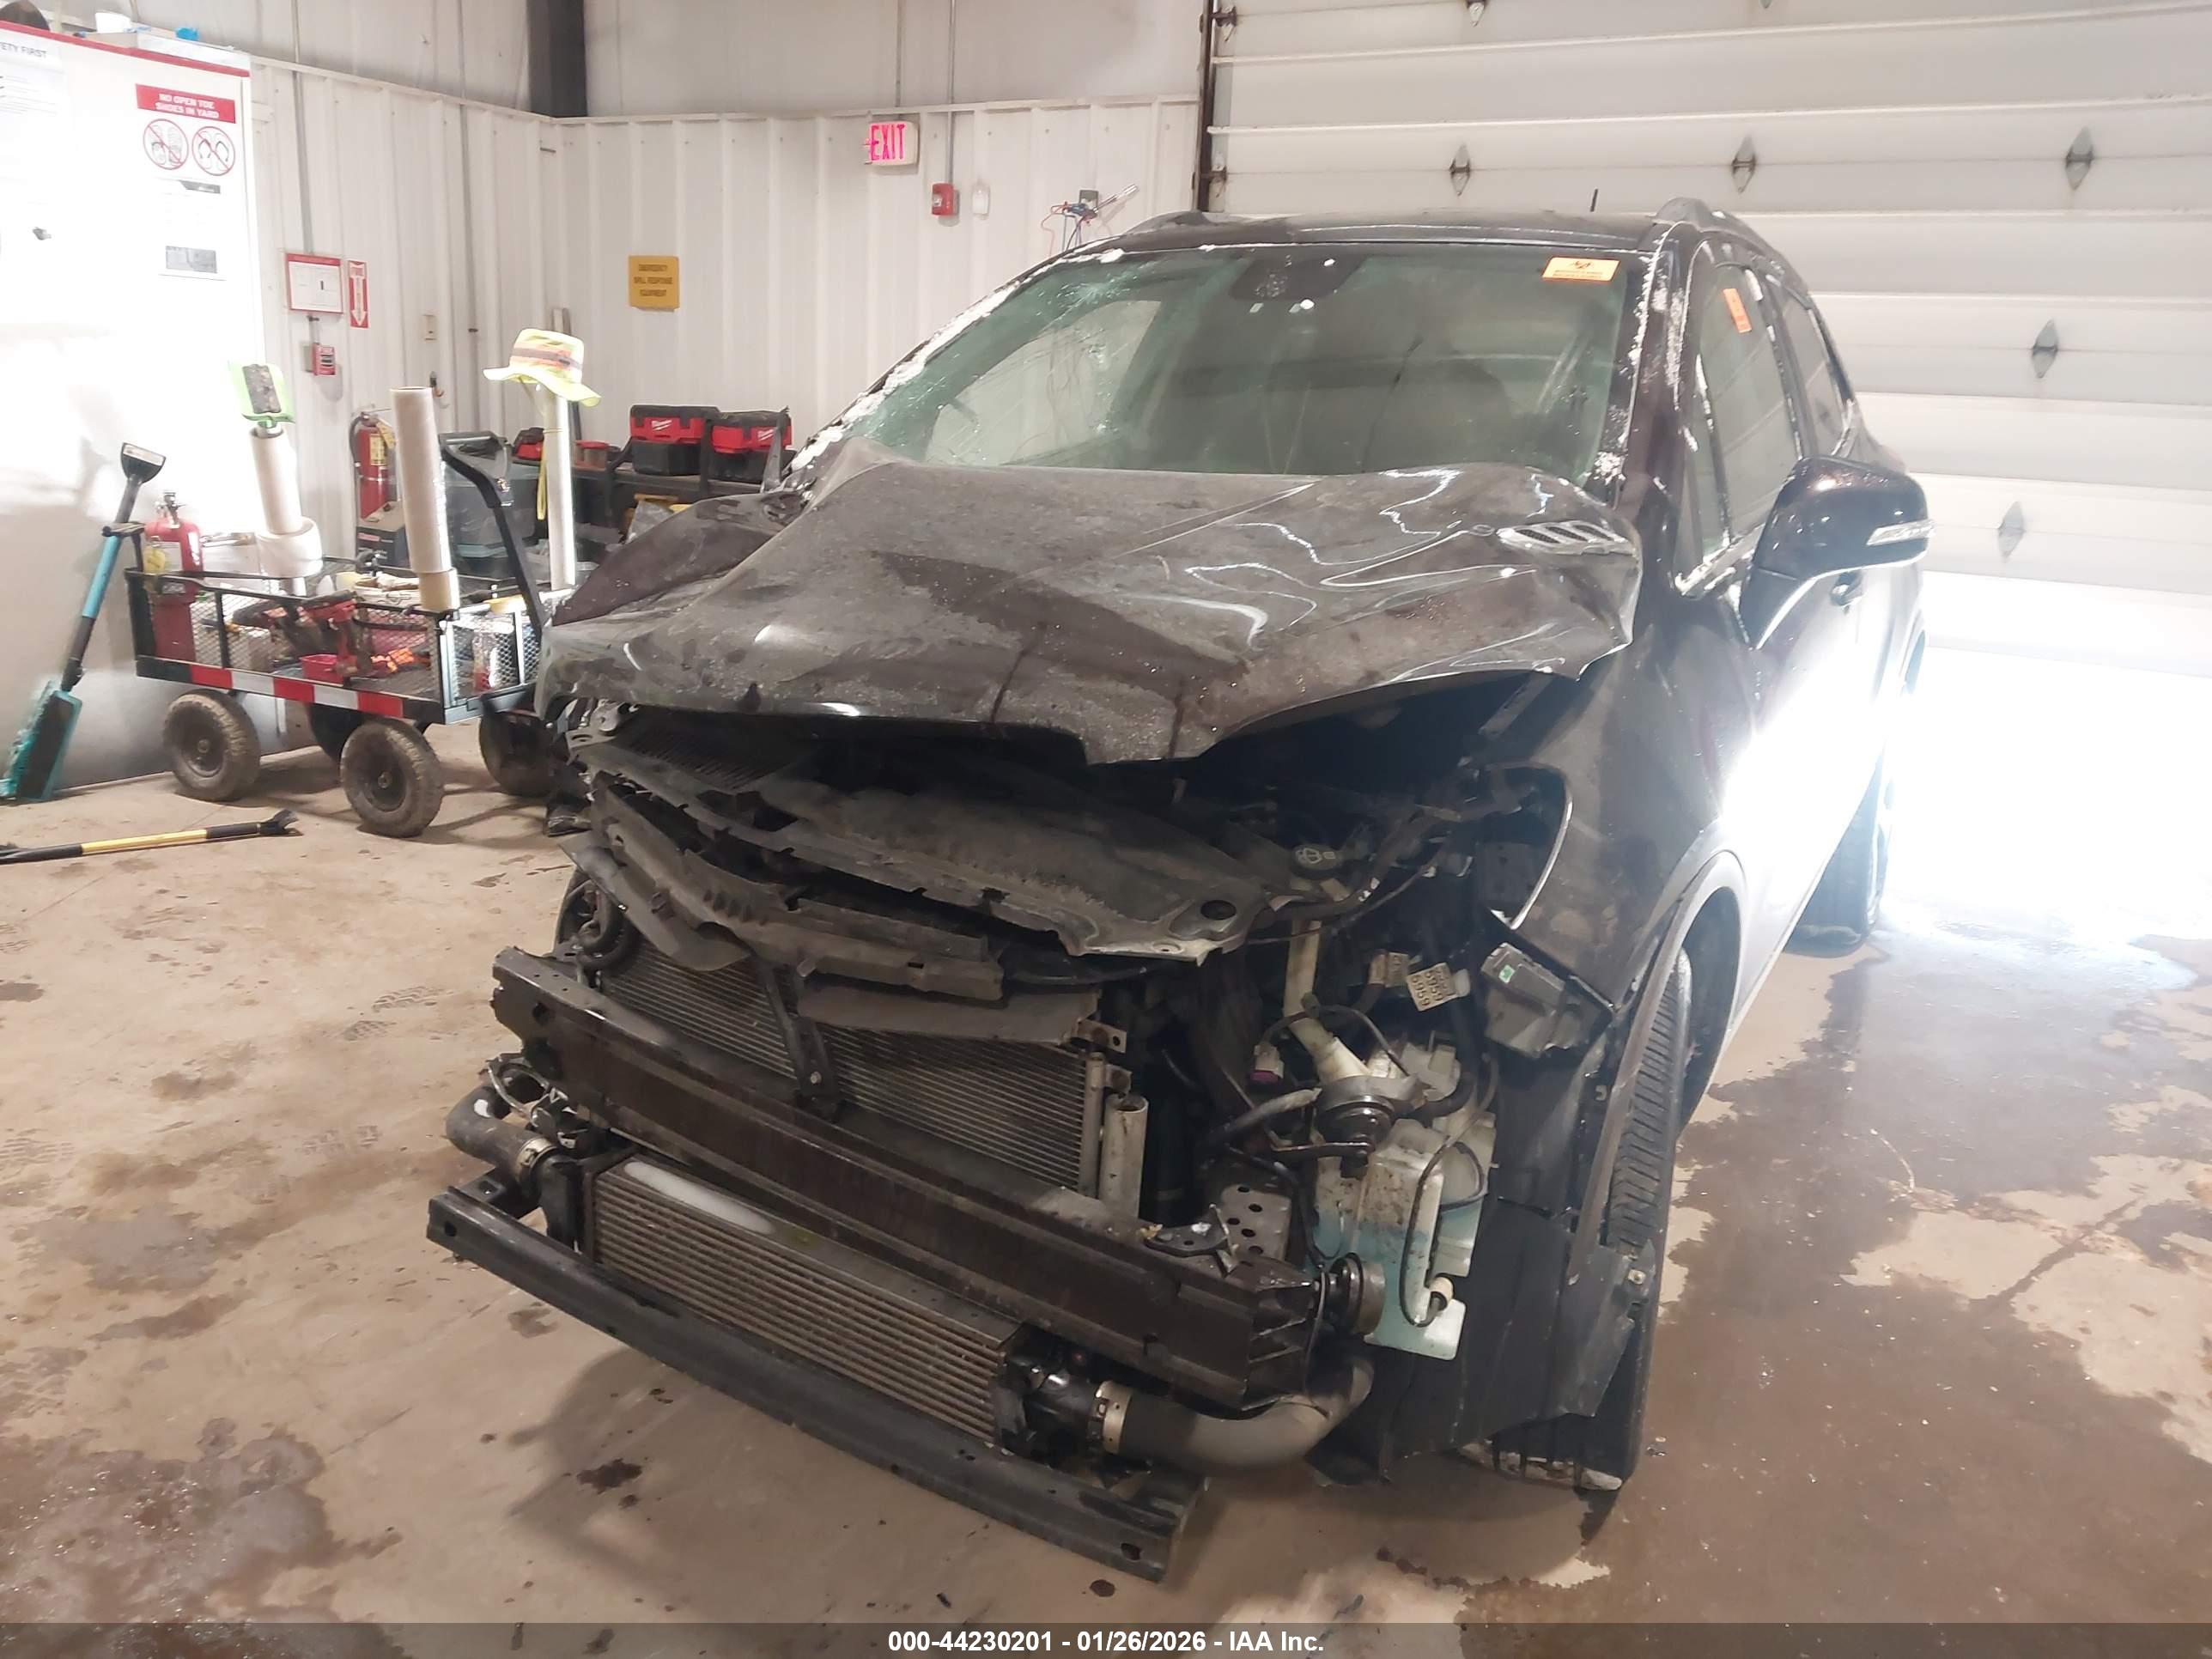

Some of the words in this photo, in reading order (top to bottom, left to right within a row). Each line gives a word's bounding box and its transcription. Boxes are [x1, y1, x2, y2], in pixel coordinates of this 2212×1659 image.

[158, 93, 173, 103] NO
[173, 96, 198, 106] OPEN
[871, 124, 905, 161] EXIT
